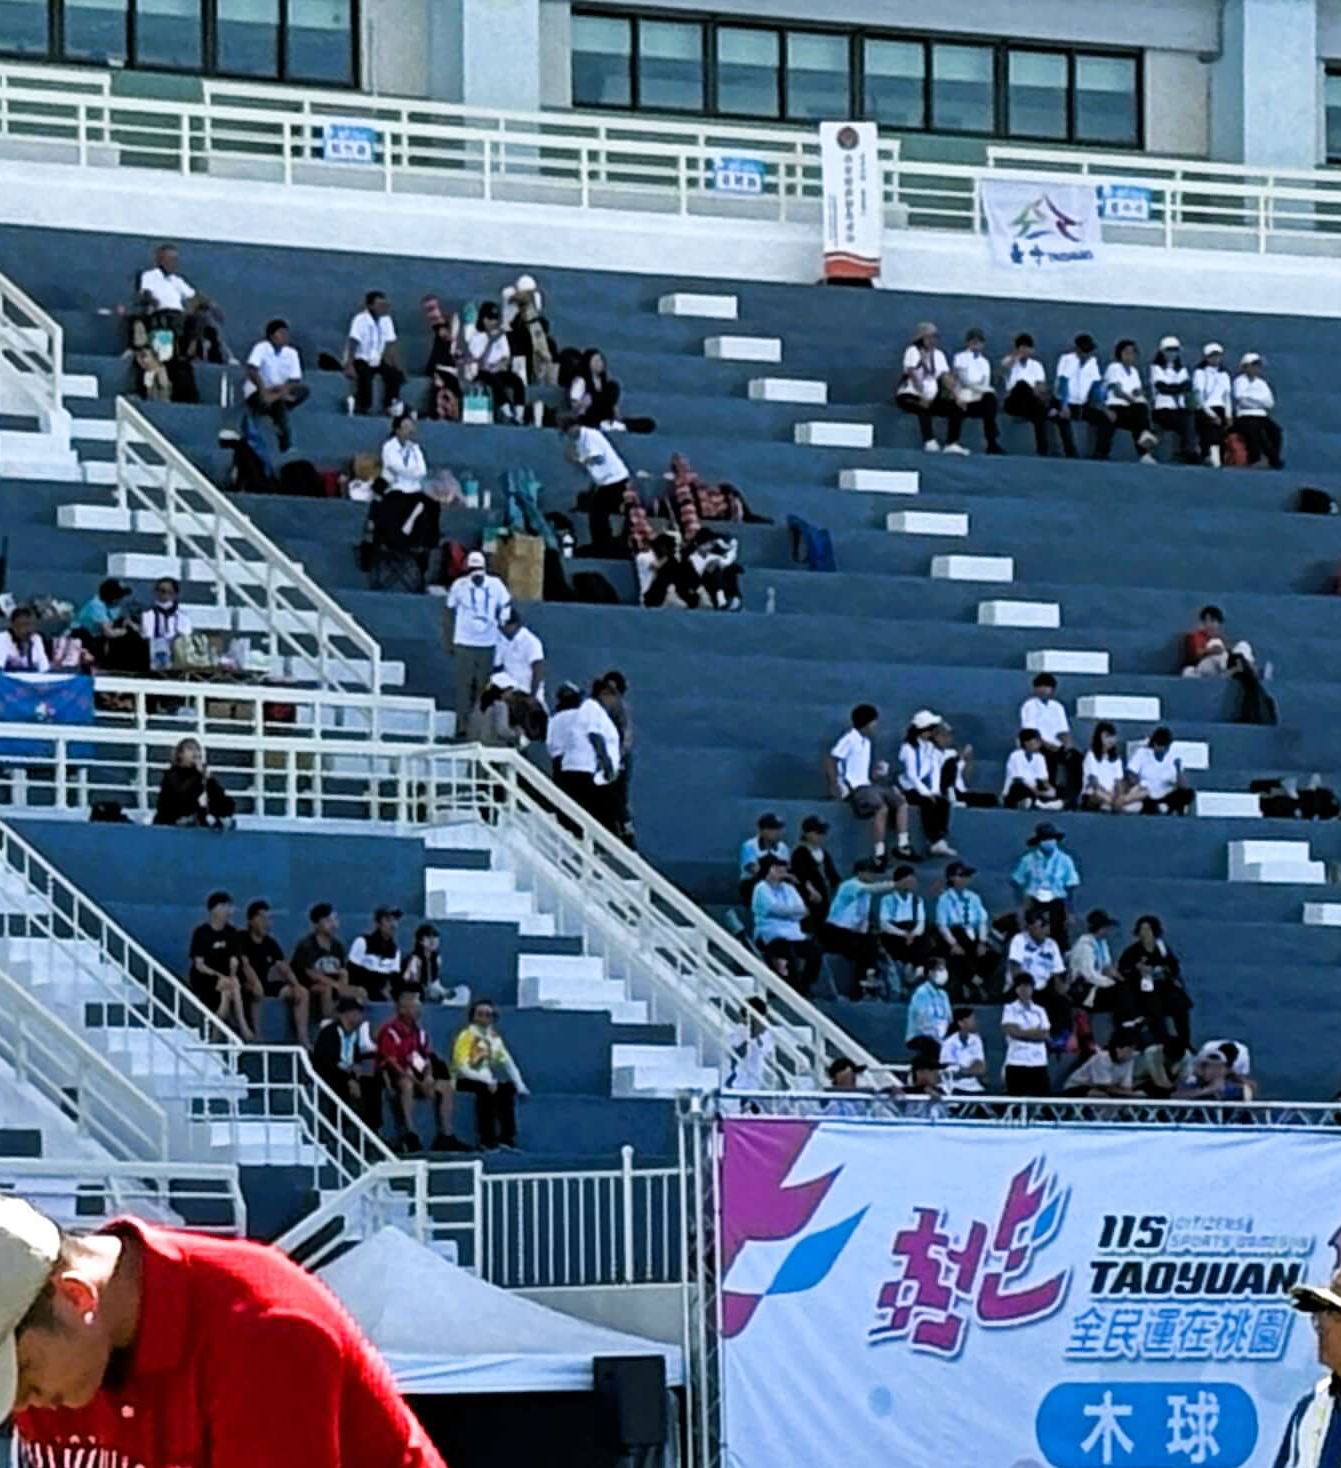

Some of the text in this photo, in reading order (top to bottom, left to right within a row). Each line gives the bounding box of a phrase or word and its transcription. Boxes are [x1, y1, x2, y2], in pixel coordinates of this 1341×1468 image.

[1098, 1215, 1167, 1248] 115
[1089, 1261, 1302, 1295] TAOYUAN
[1065, 1307, 1289, 1352] 全民運在桃園
[1080, 1390, 1221, 1465] 木球
